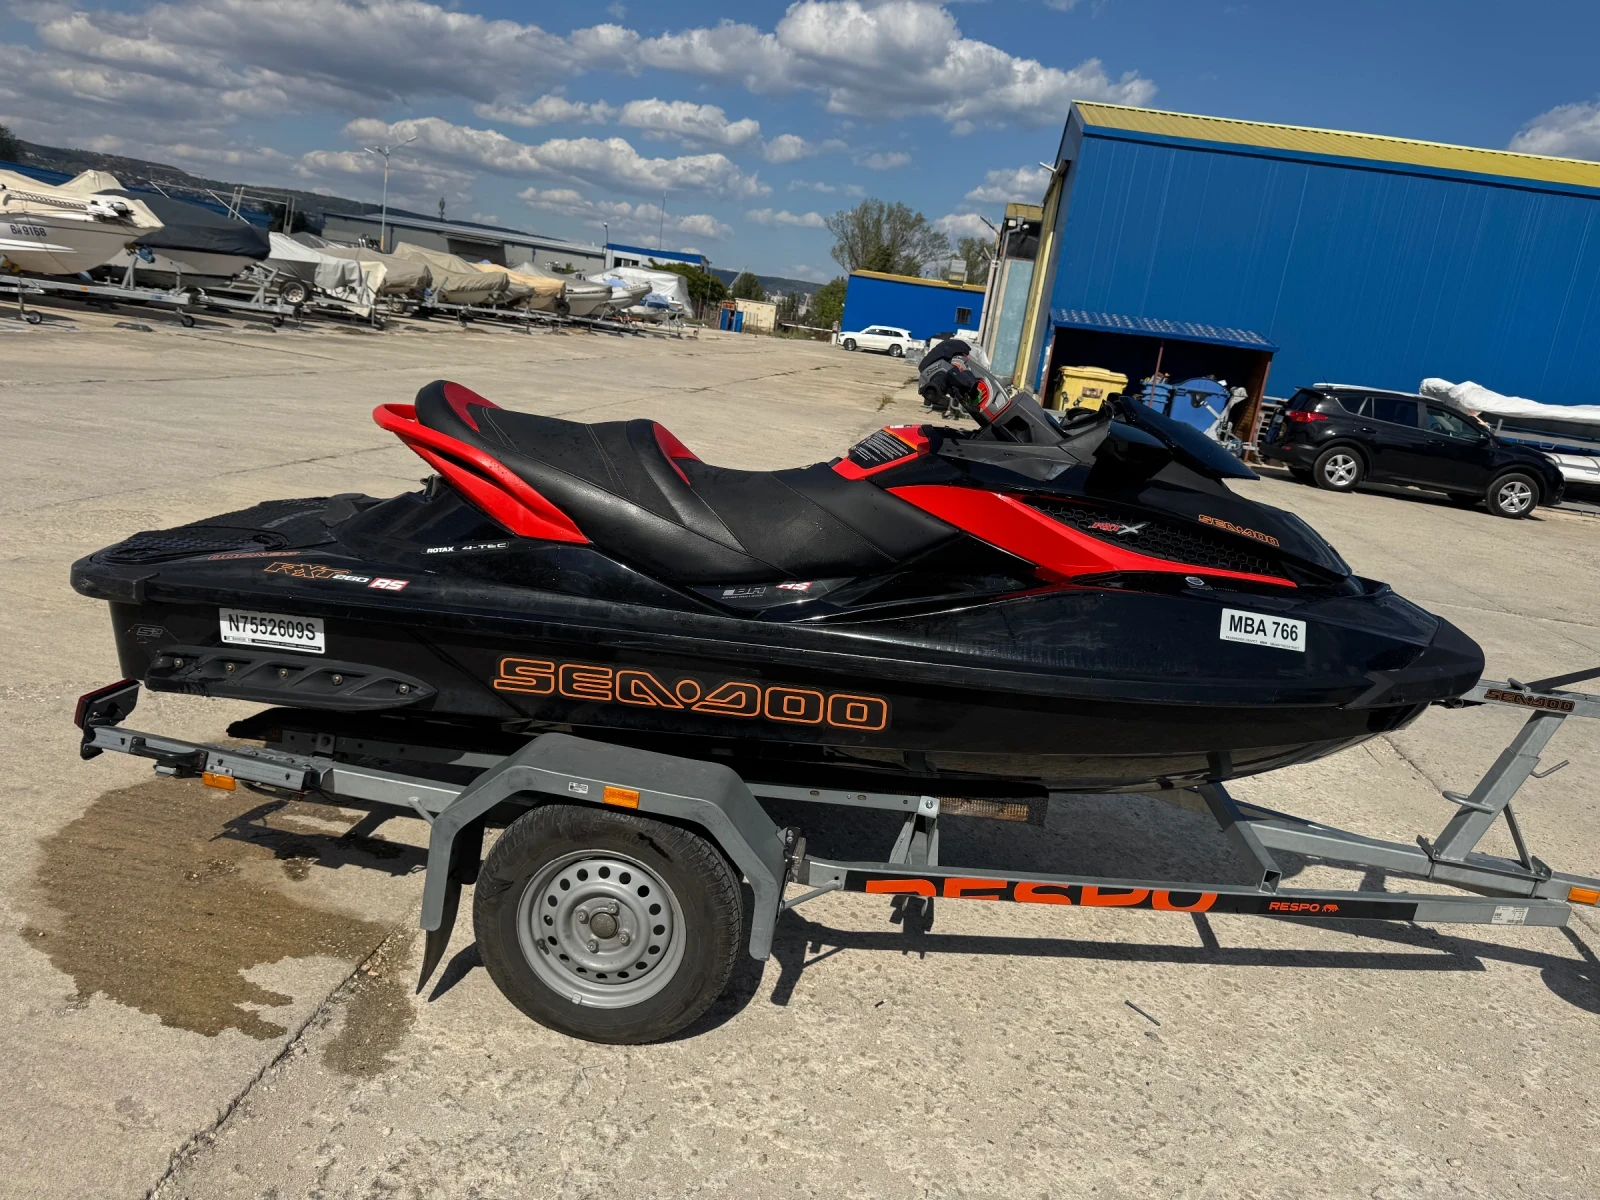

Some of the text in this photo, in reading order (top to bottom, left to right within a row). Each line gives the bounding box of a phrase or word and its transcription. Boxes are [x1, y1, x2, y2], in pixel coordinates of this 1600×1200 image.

[369, 578, 408, 591] RS
[228, 614, 315, 640] N7552609S
[1229, 615, 1298, 642] MBA 766
[1269, 902, 1320, 912] RESPO
